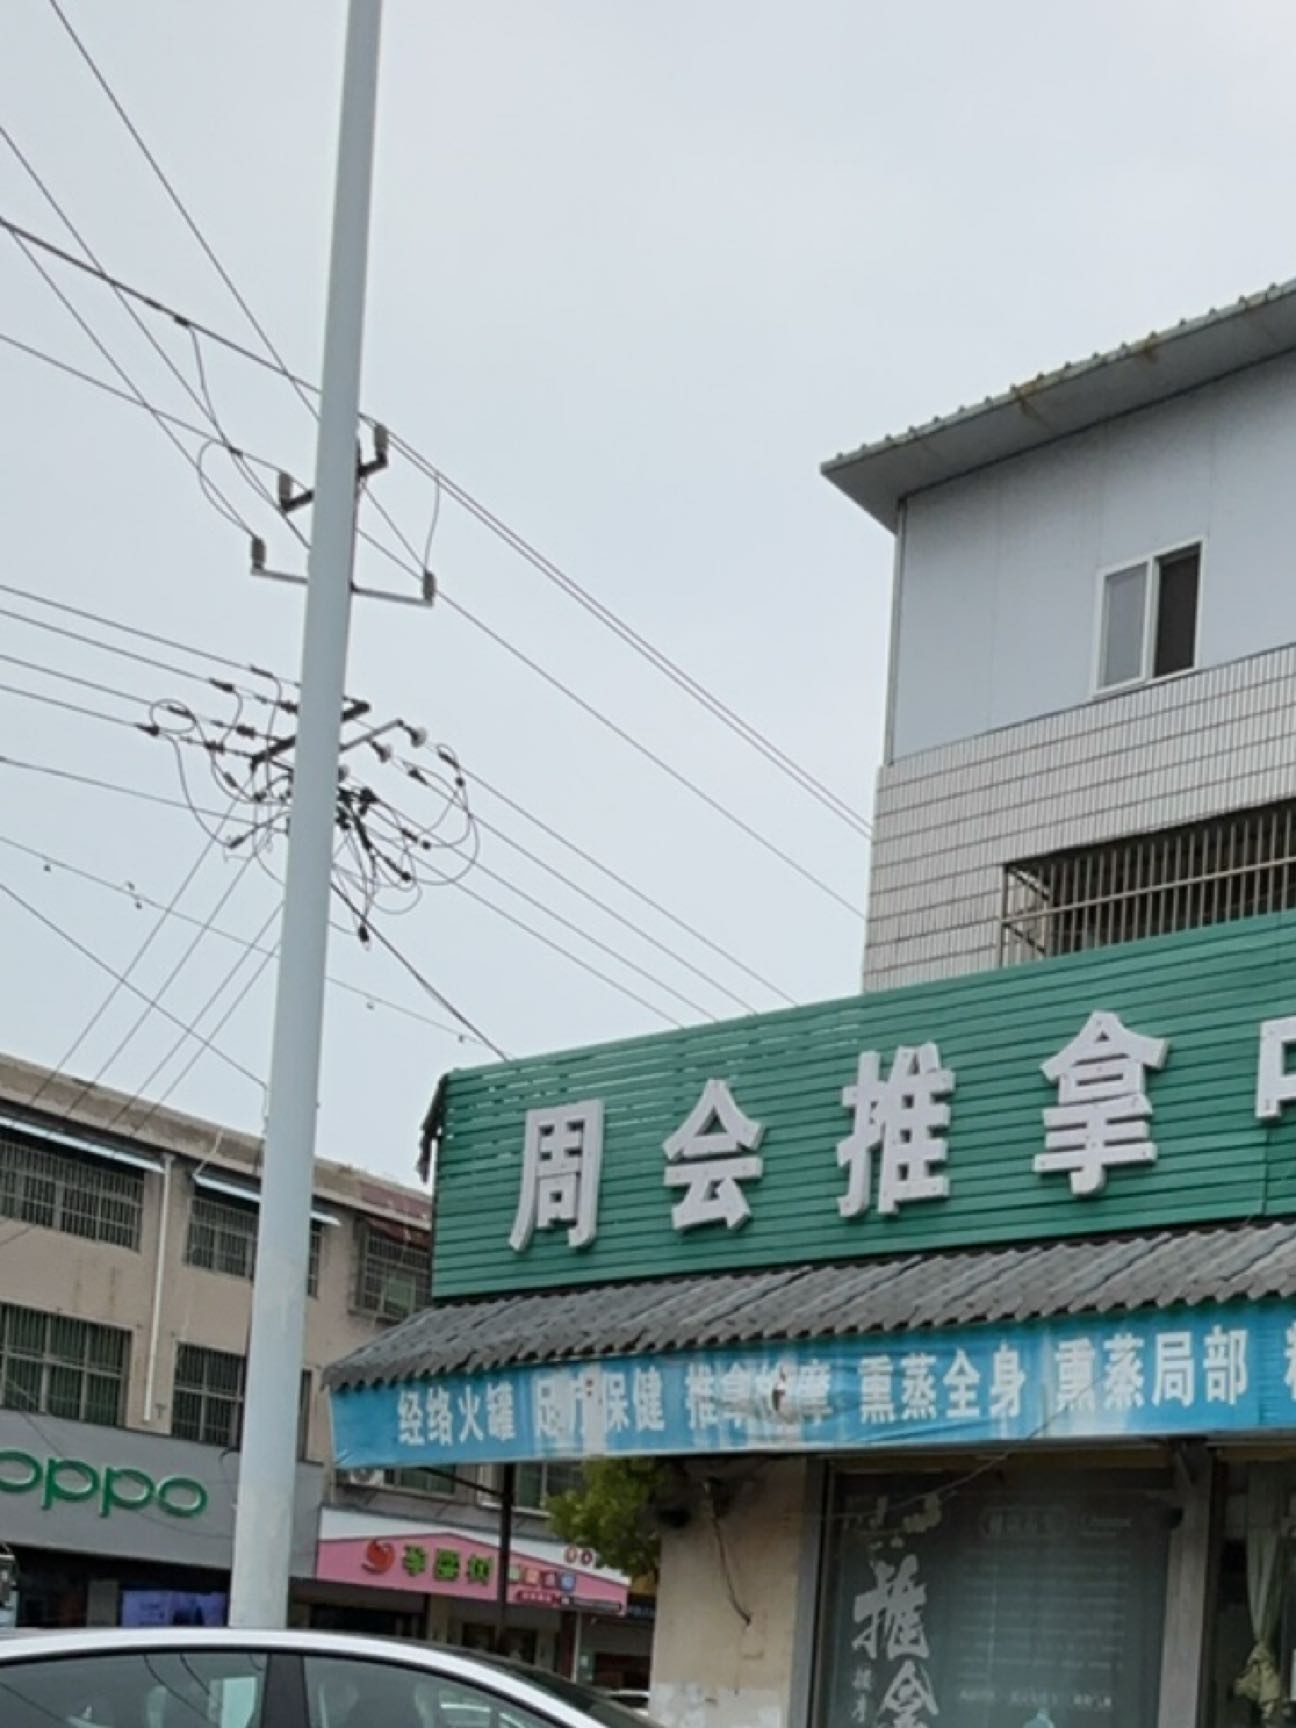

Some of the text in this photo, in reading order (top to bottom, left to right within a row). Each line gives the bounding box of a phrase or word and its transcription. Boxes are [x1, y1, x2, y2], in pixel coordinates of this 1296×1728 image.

[397, 1381, 516, 1447] 经络火罐
[858, 1341, 1026, 1424] 熏蒸全身
[1053, 1324, 1250, 1413] 熏蒸局部
